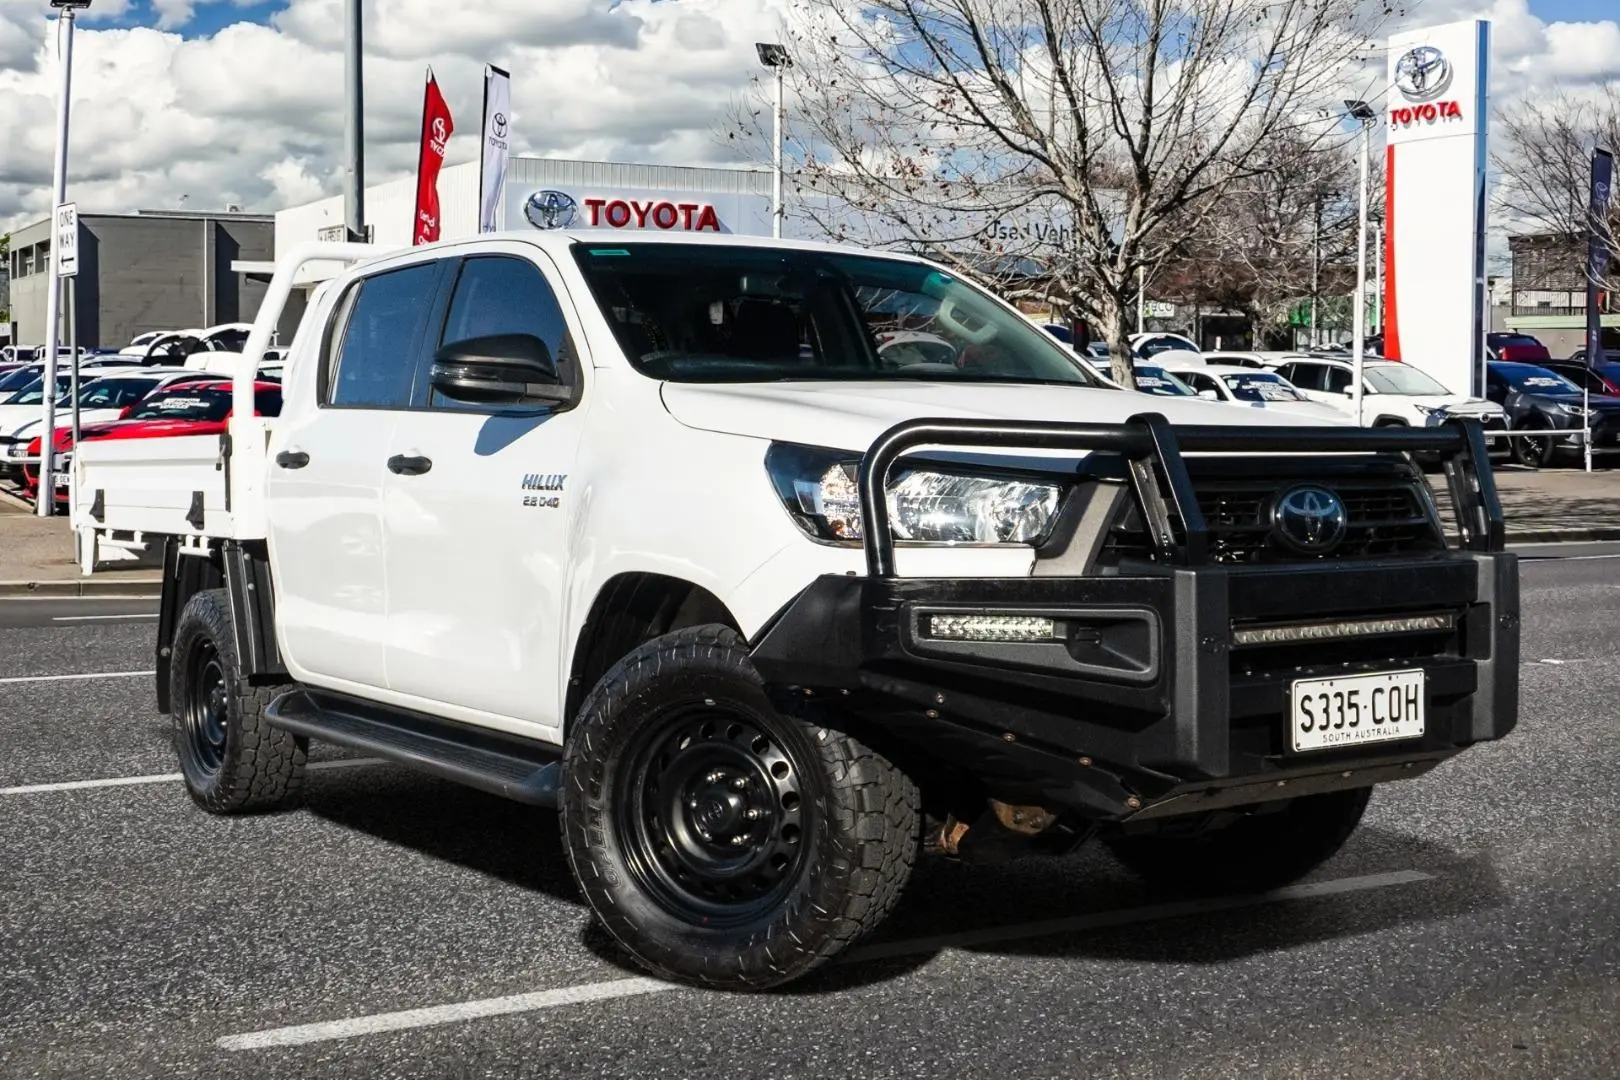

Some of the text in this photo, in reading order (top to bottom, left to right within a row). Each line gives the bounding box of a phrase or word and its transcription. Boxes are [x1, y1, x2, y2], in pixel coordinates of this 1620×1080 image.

[1390, 101, 1462, 124] TOYOTA
[60, 209, 74, 227] ONE
[585, 199, 721, 232] TOYOTA
[59, 231, 76, 249] WAY
[521, 474, 568, 491] HILUX
[1322, 726, 1400, 743] SOUTH AUSTRALIA
